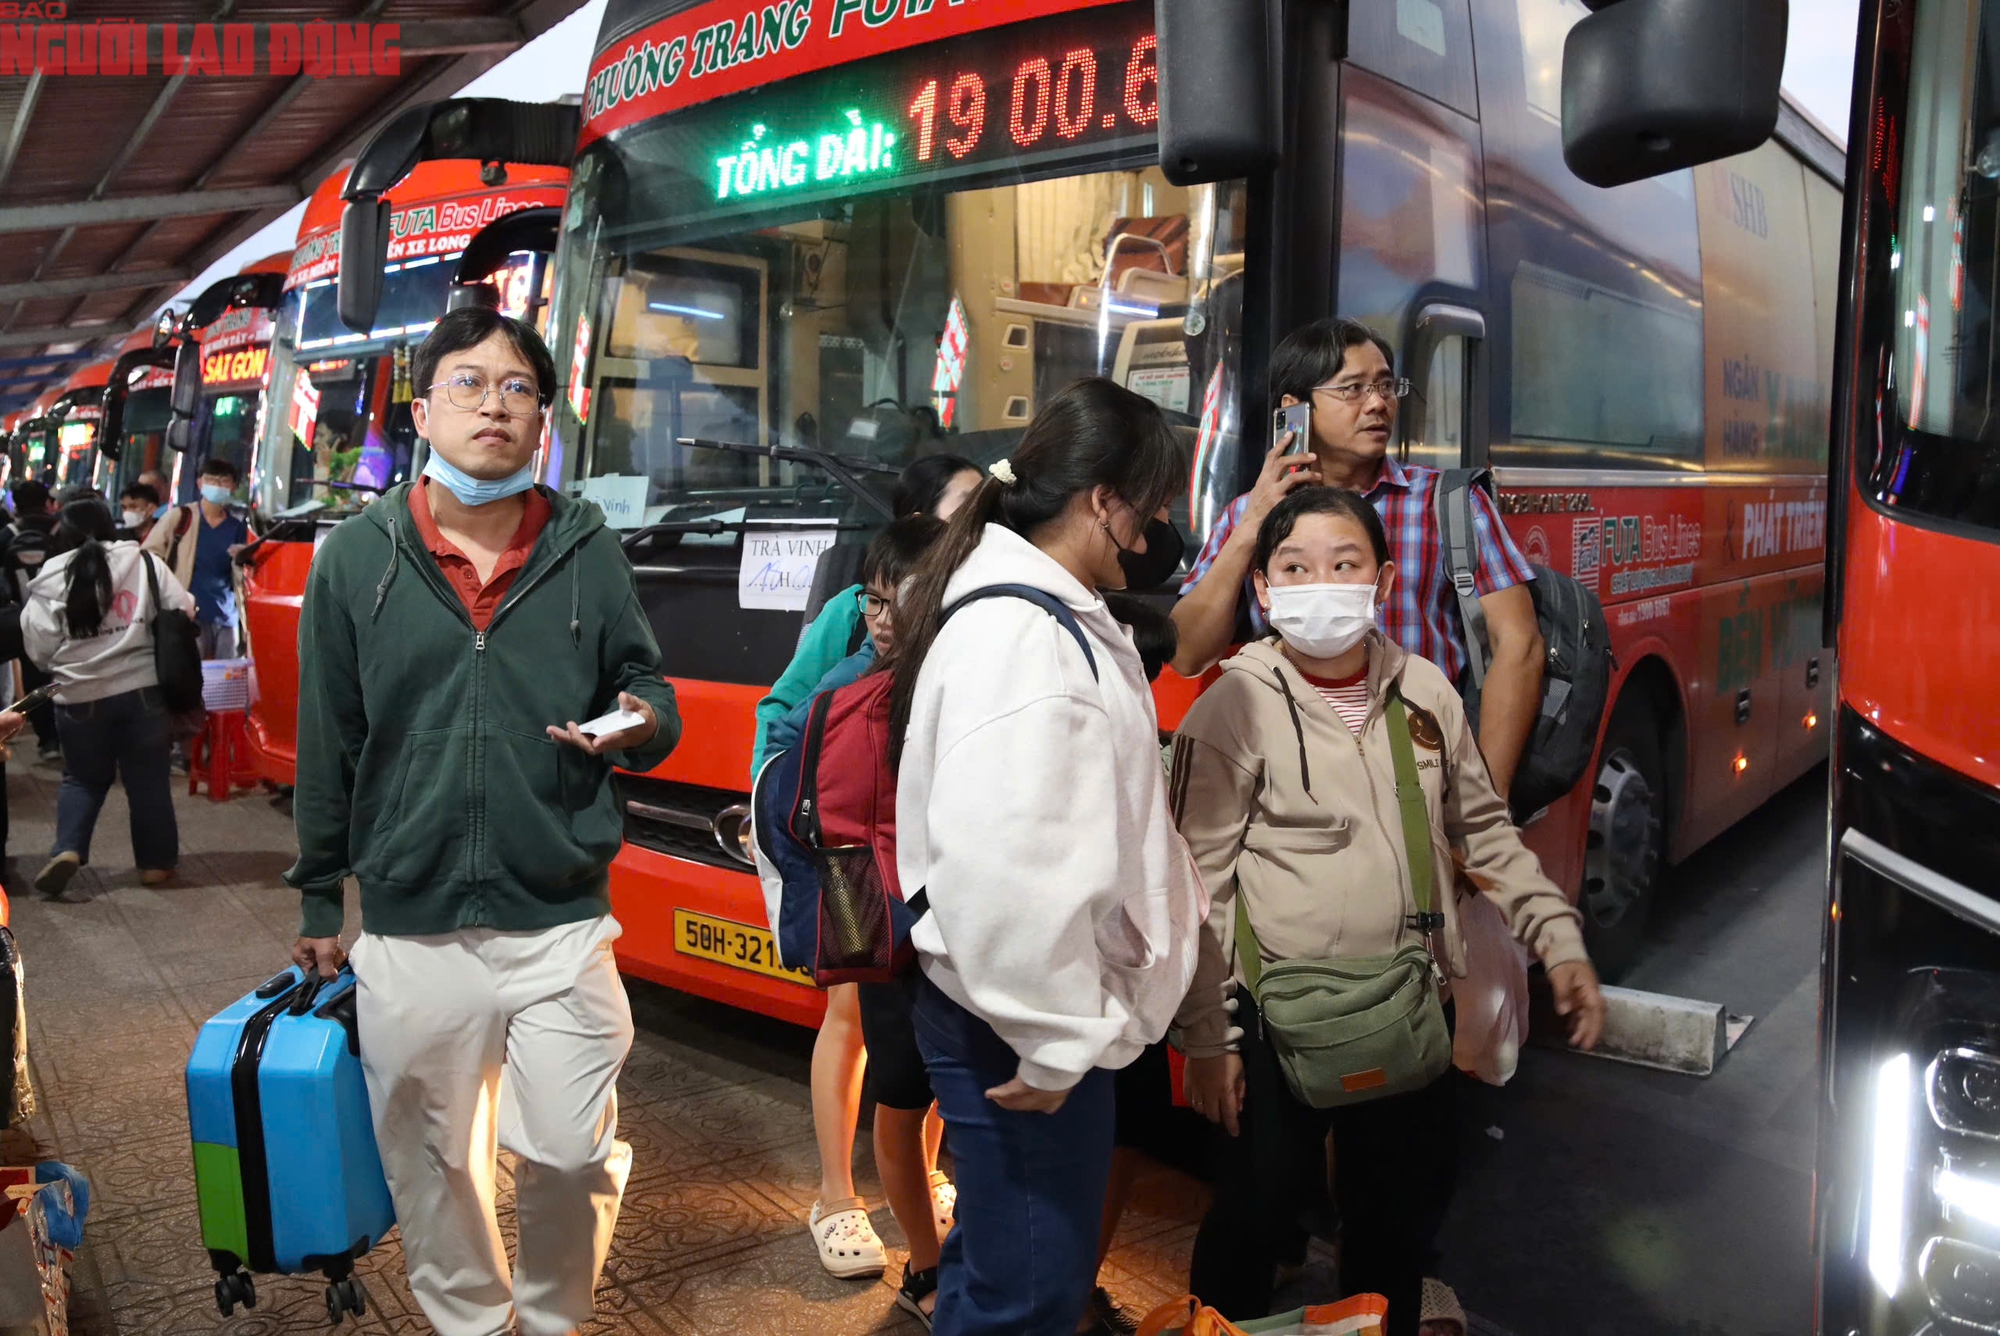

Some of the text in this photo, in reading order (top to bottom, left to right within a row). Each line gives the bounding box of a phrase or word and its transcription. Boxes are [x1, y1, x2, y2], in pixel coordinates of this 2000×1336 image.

[583, 40, 687, 127] PHƯƠNG
[689, 1, 812, 78] TRANG
[717, 124, 809, 198] TỔNG
[387, 234, 471, 259] ẾN XE LONG
[603, 498, 631, 514] Vinh
[1743, 488, 1785, 559] PHÁT
[751, 534, 828, 556] TRÀ VINH
[1602, 516, 1641, 567] FUTA
[686, 920, 811, 977] 50H-321.
